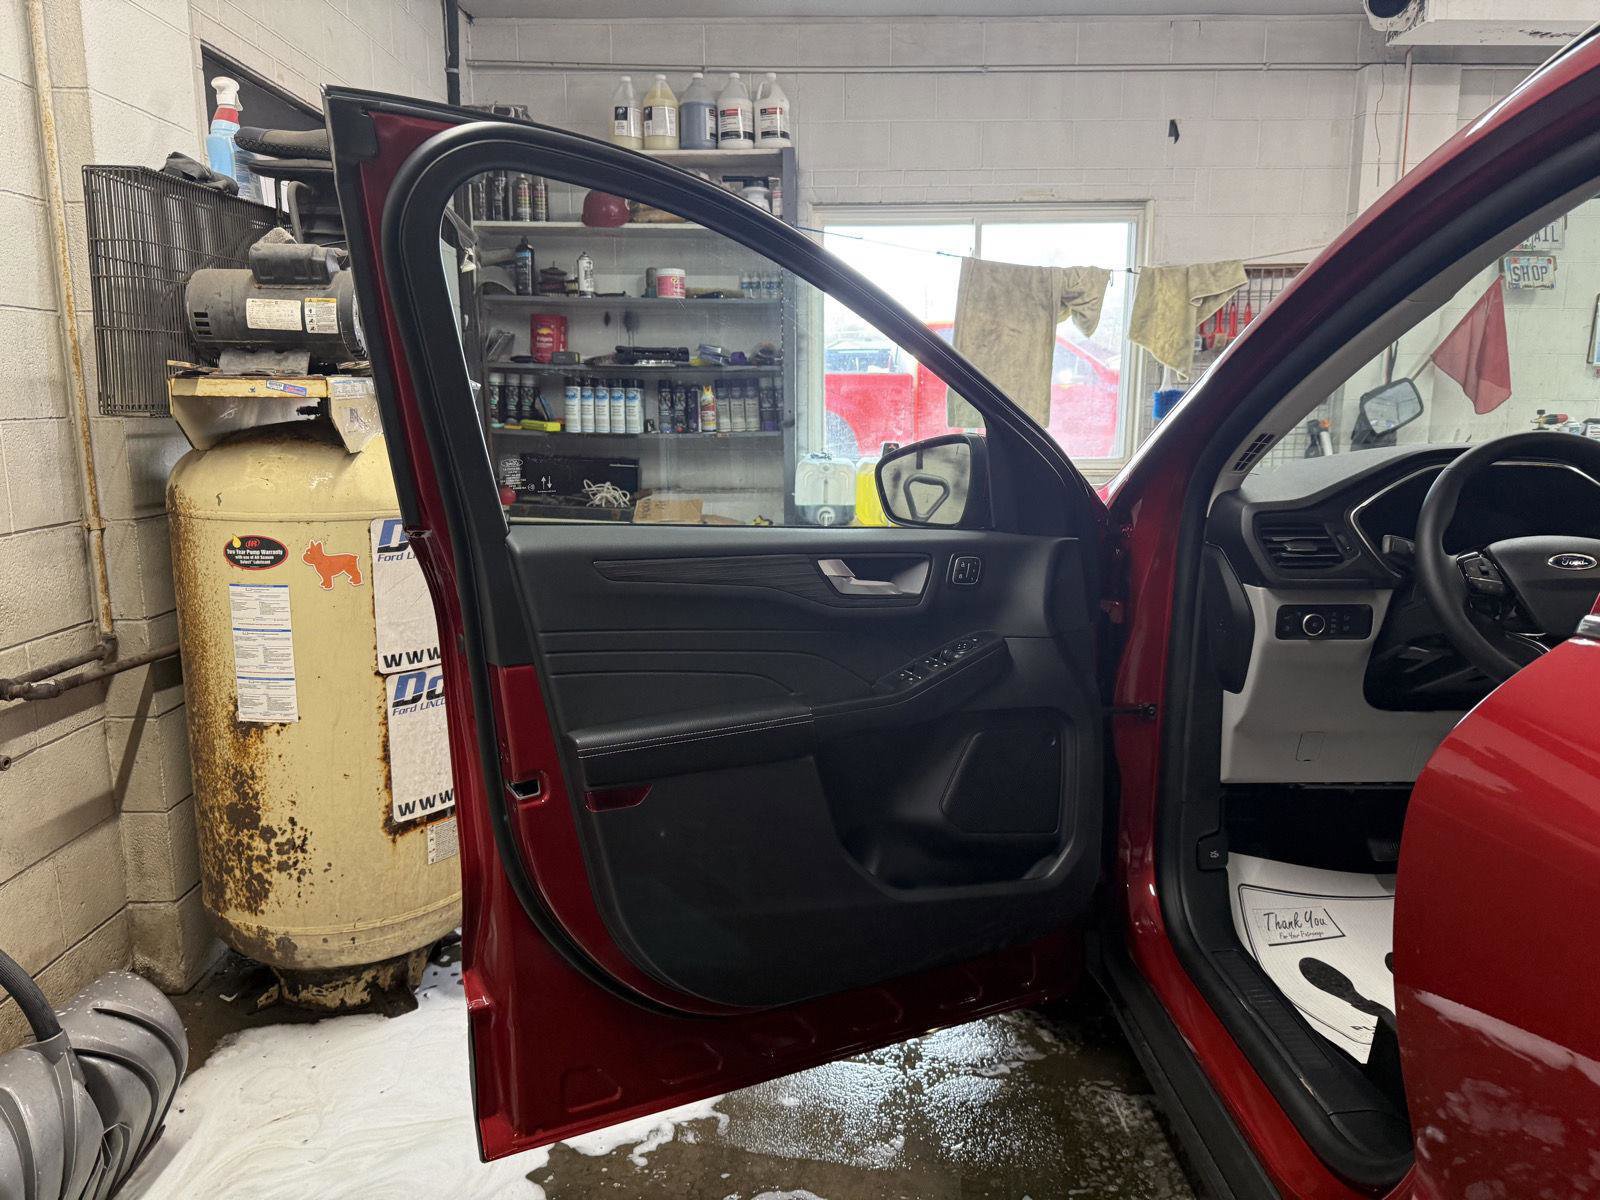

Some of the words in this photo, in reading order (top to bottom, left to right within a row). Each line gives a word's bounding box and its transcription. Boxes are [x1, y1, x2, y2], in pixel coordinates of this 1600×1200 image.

[1512, 264, 1548, 282] SHOP
[377, 552, 404, 562] Ford
[392, 704, 417, 716] Ford
[1263, 911, 1302, 931] Thank
[1304, 910, 1328, 928] You
